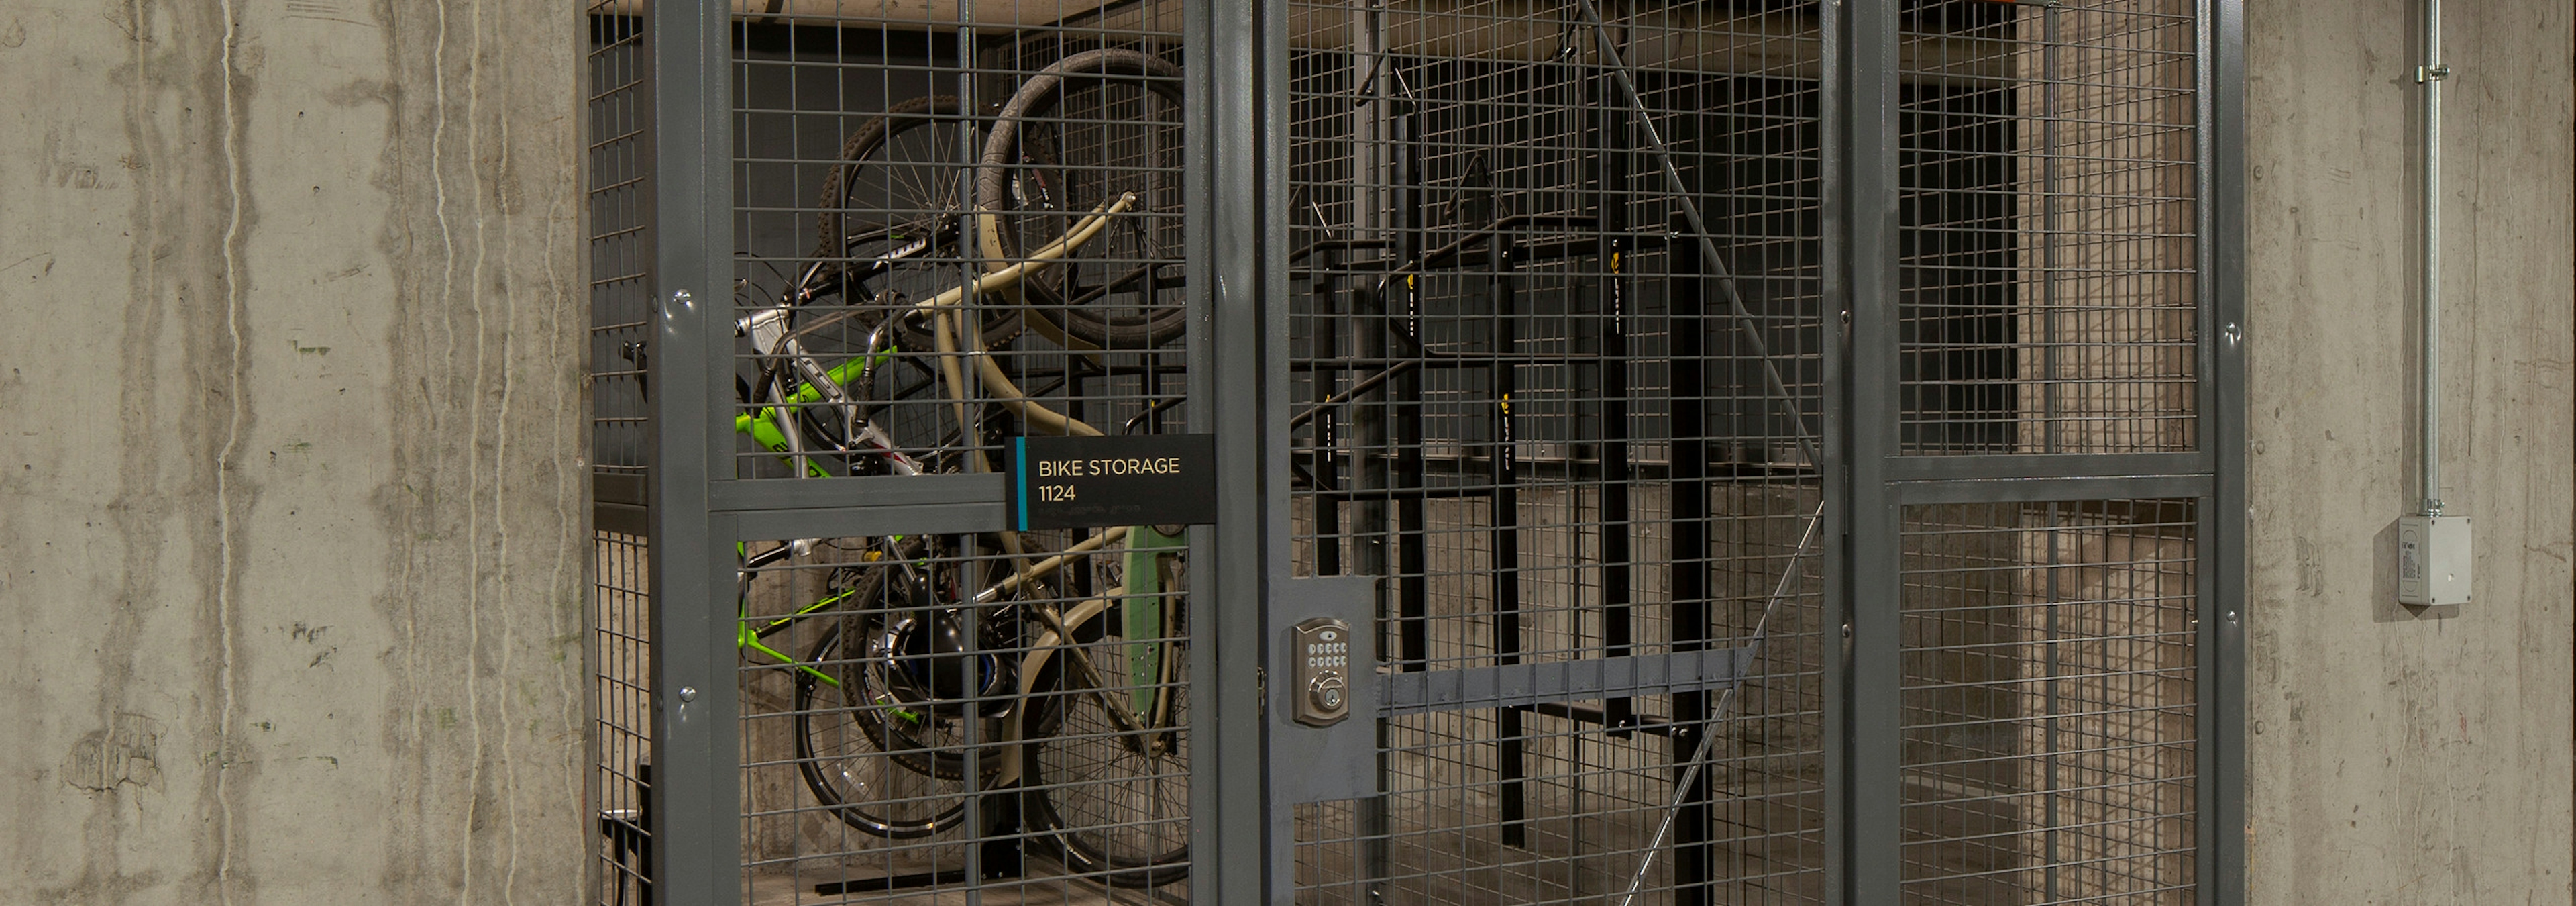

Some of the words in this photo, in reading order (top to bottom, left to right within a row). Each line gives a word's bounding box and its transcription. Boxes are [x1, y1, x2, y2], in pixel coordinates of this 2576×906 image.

[1039, 460, 1083, 477] BIKE
[1089, 457, 1181, 476] STORAGE
[1038, 485, 1076, 501] 1124
